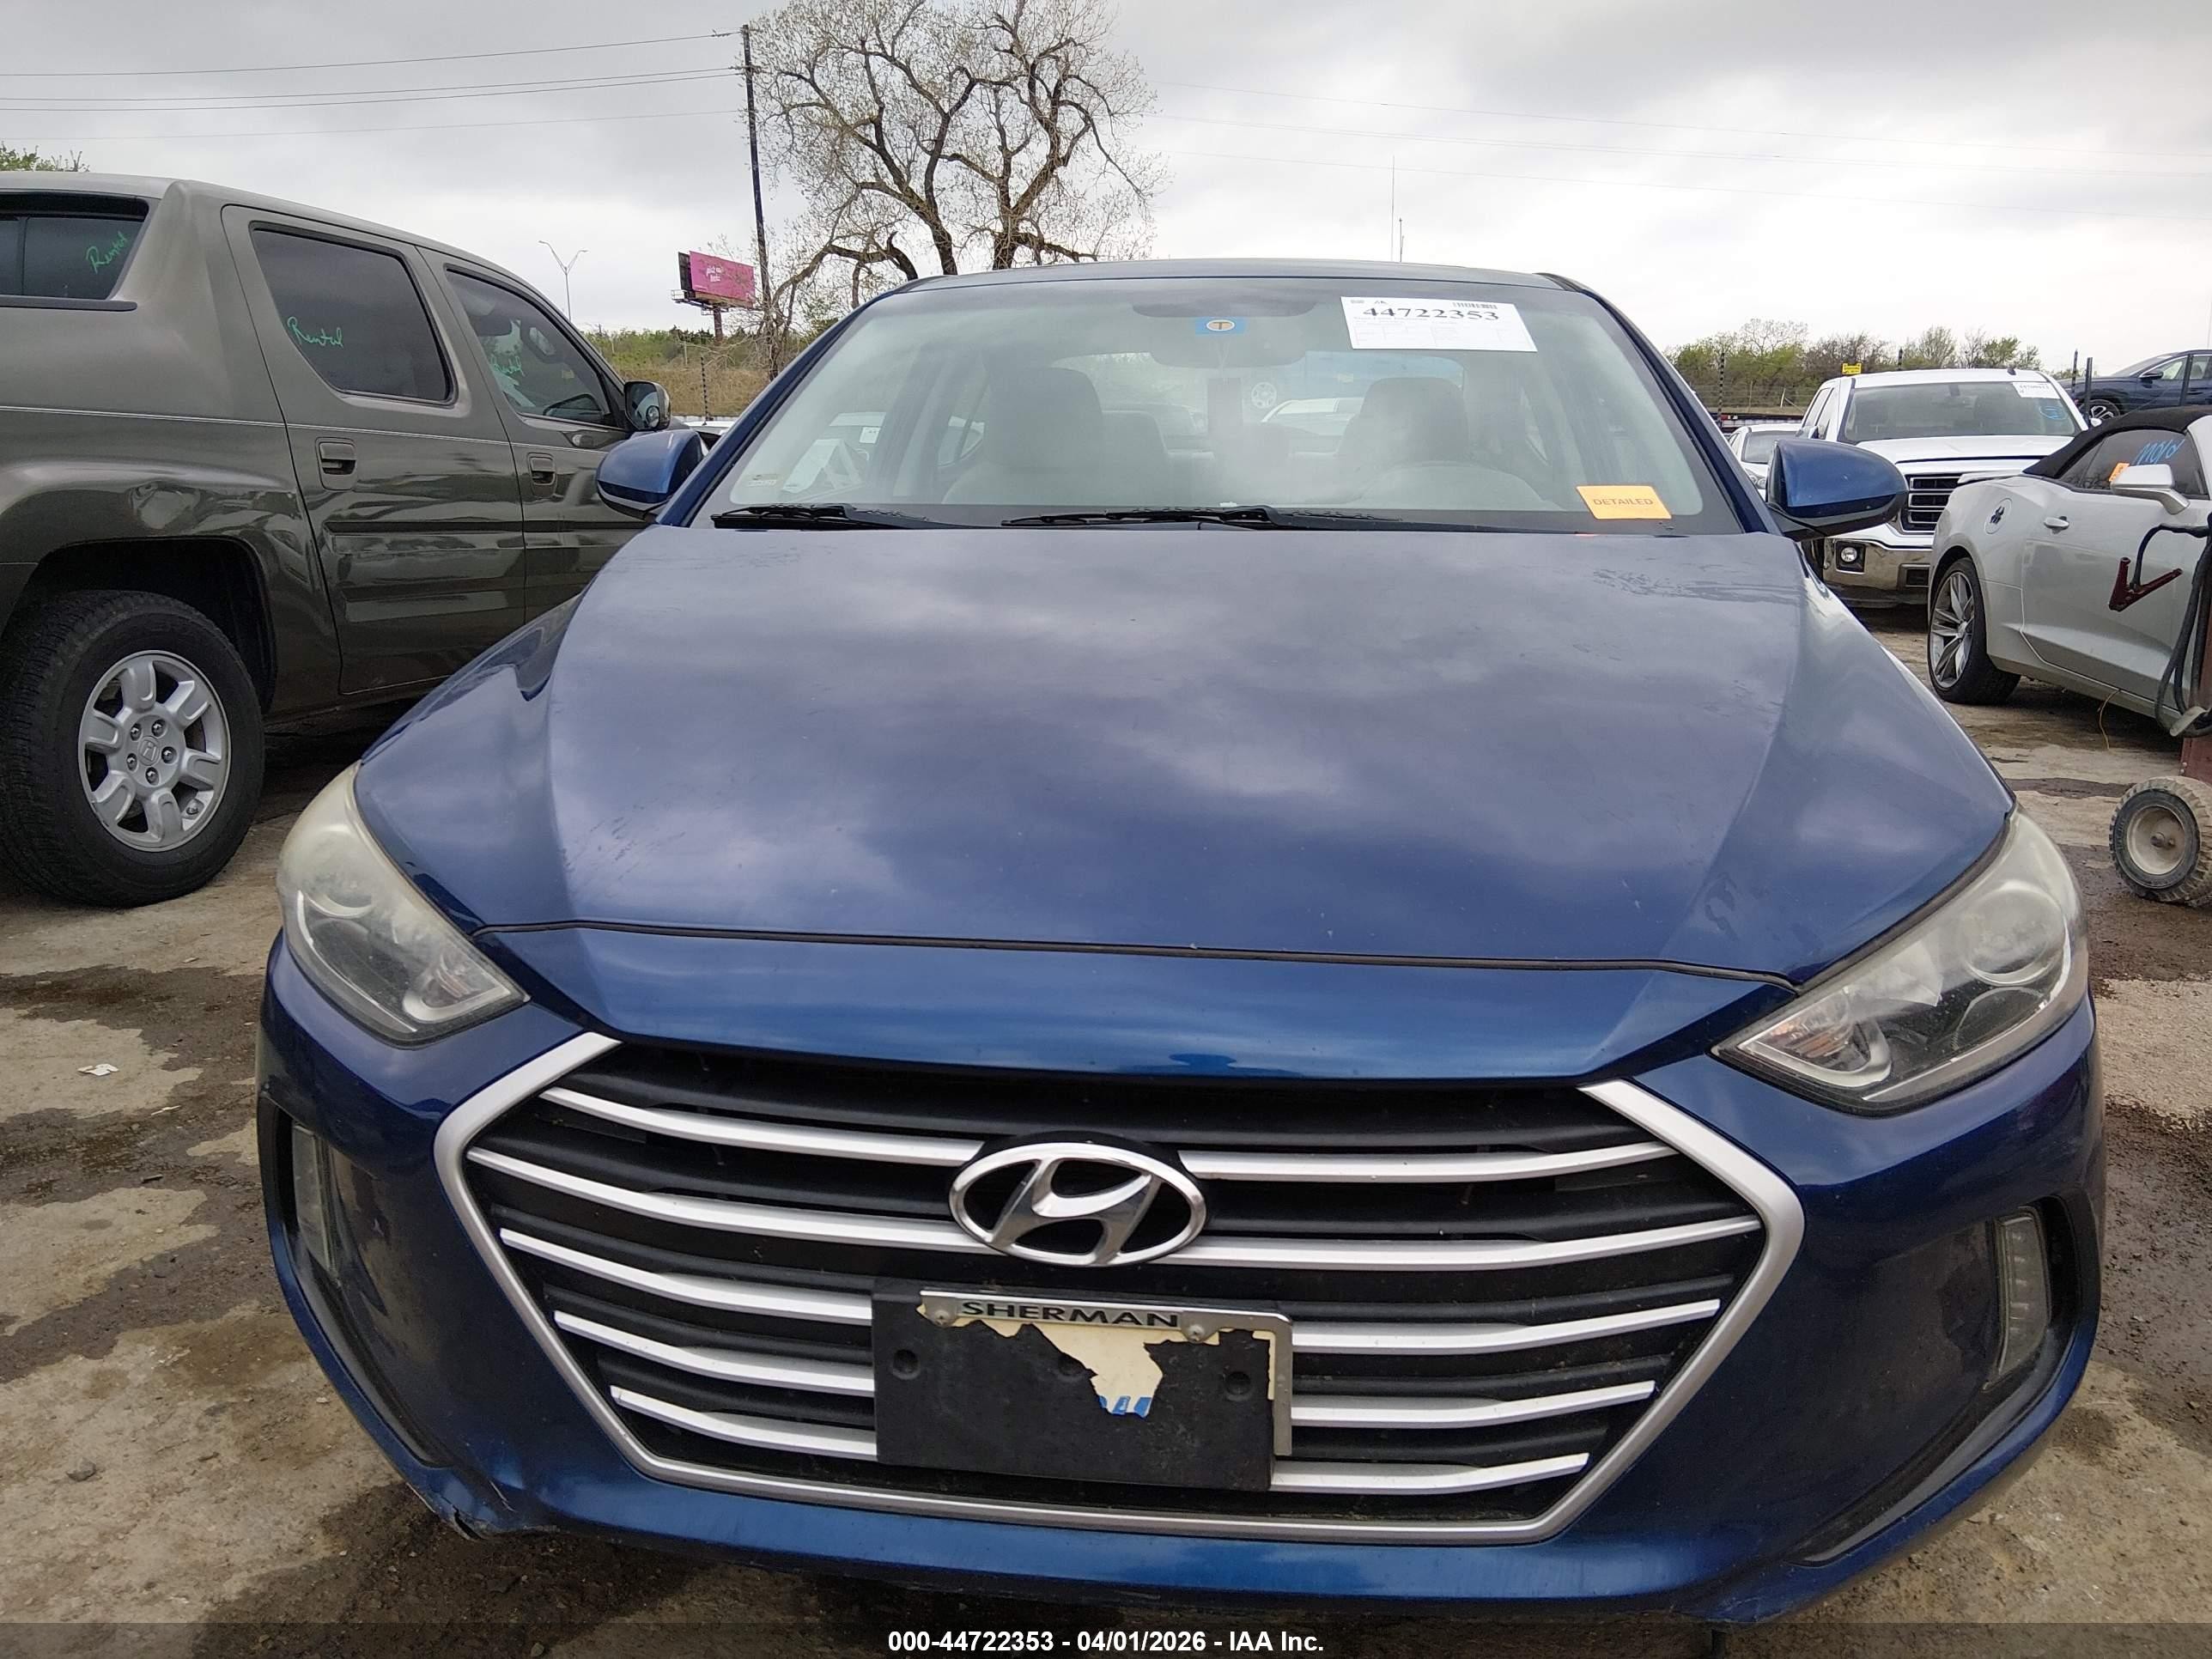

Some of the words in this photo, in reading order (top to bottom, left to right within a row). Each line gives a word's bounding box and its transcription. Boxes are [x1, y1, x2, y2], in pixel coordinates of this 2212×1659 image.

[1363, 307, 1499, 321] 44722353
[1593, 497, 1654, 506] DETAILED
[962, 1302, 1179, 1328] SHERMAN
